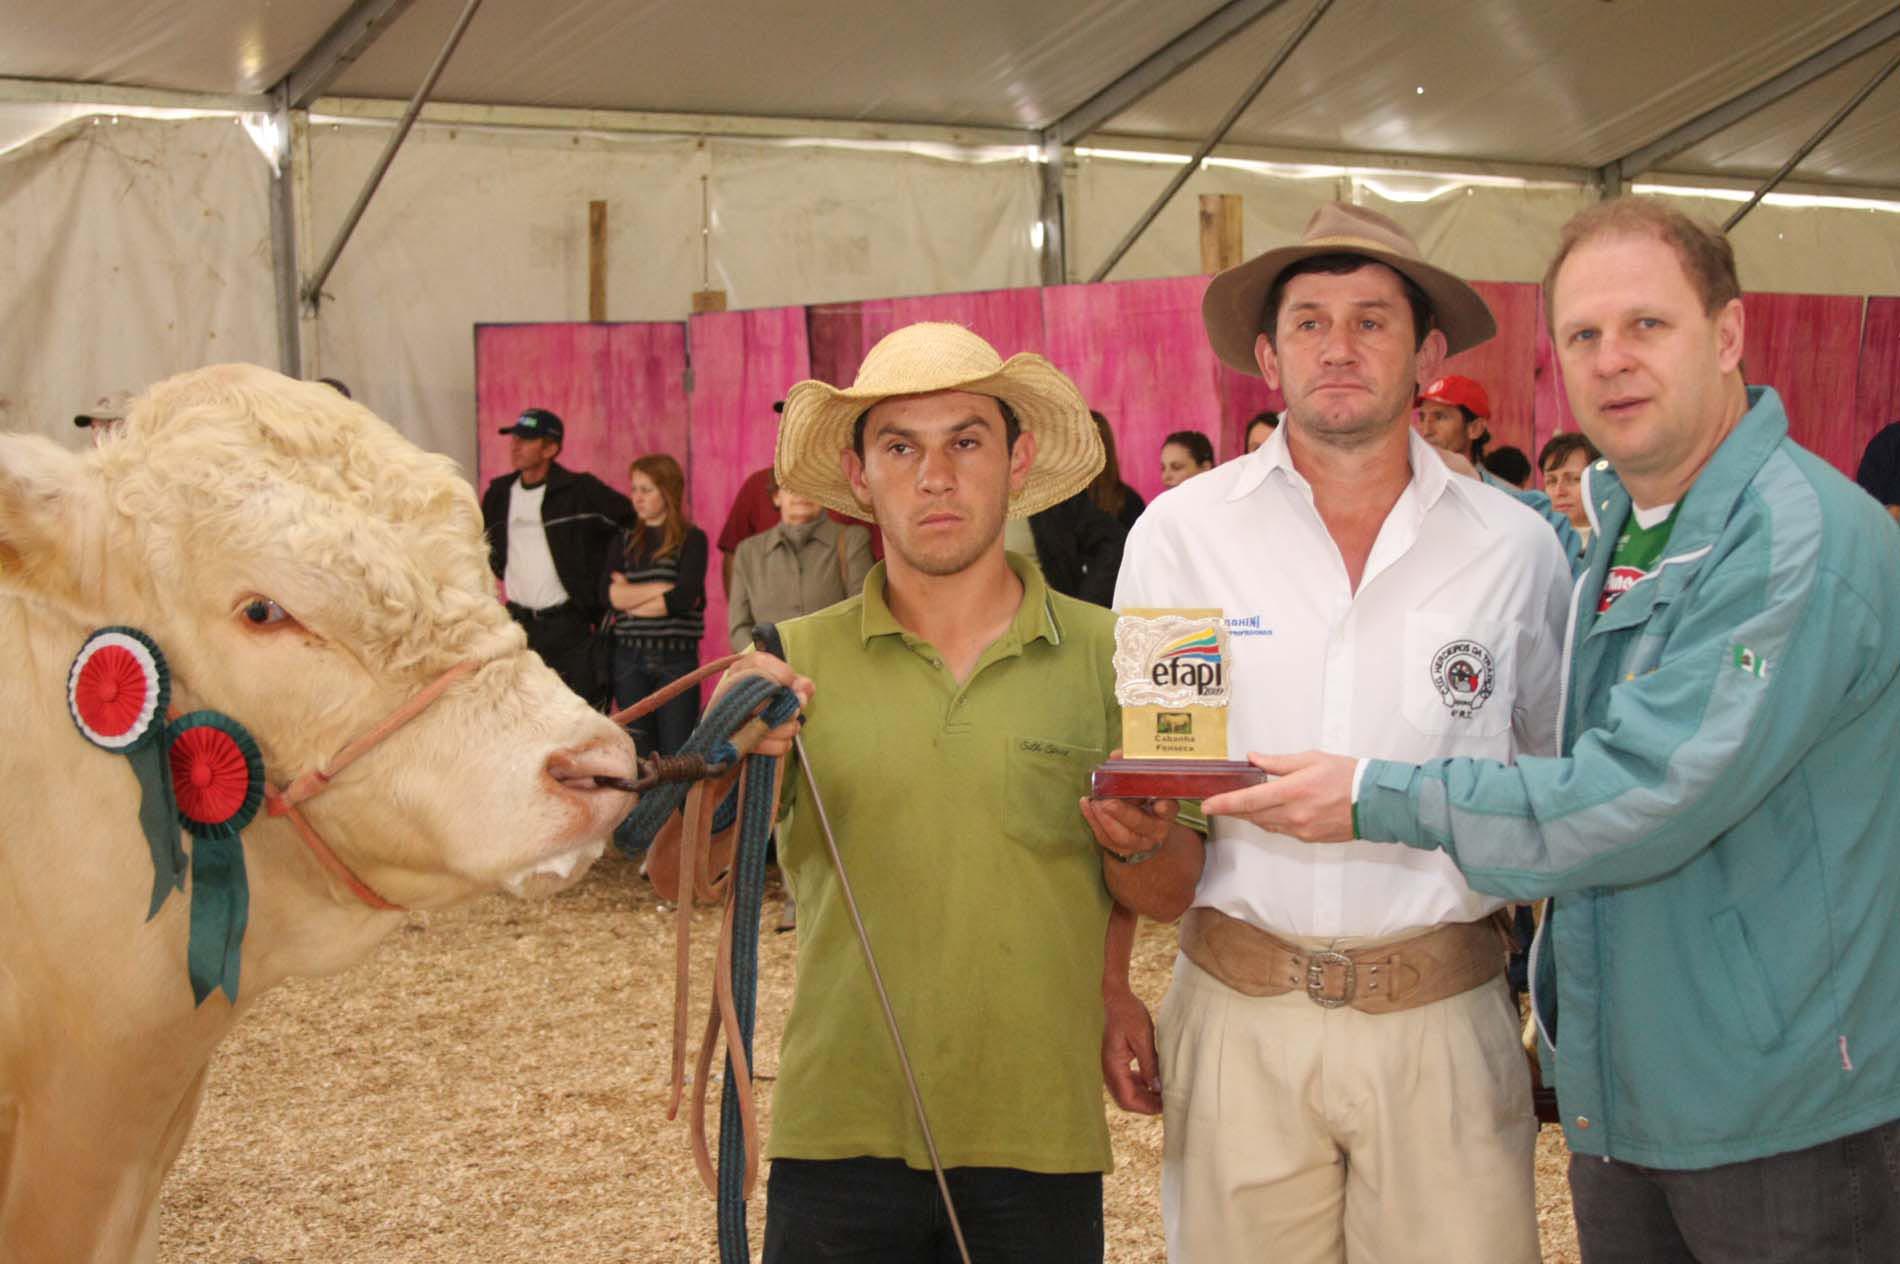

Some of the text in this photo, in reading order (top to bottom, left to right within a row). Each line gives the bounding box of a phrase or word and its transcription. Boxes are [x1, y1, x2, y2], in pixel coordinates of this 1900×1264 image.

[1471, 646, 1483, 657] DA
[1151, 656, 1222, 696] efapi
[1154, 734, 1196, 743] Cabanha
[1155, 744, 1195, 752] Fonseca
